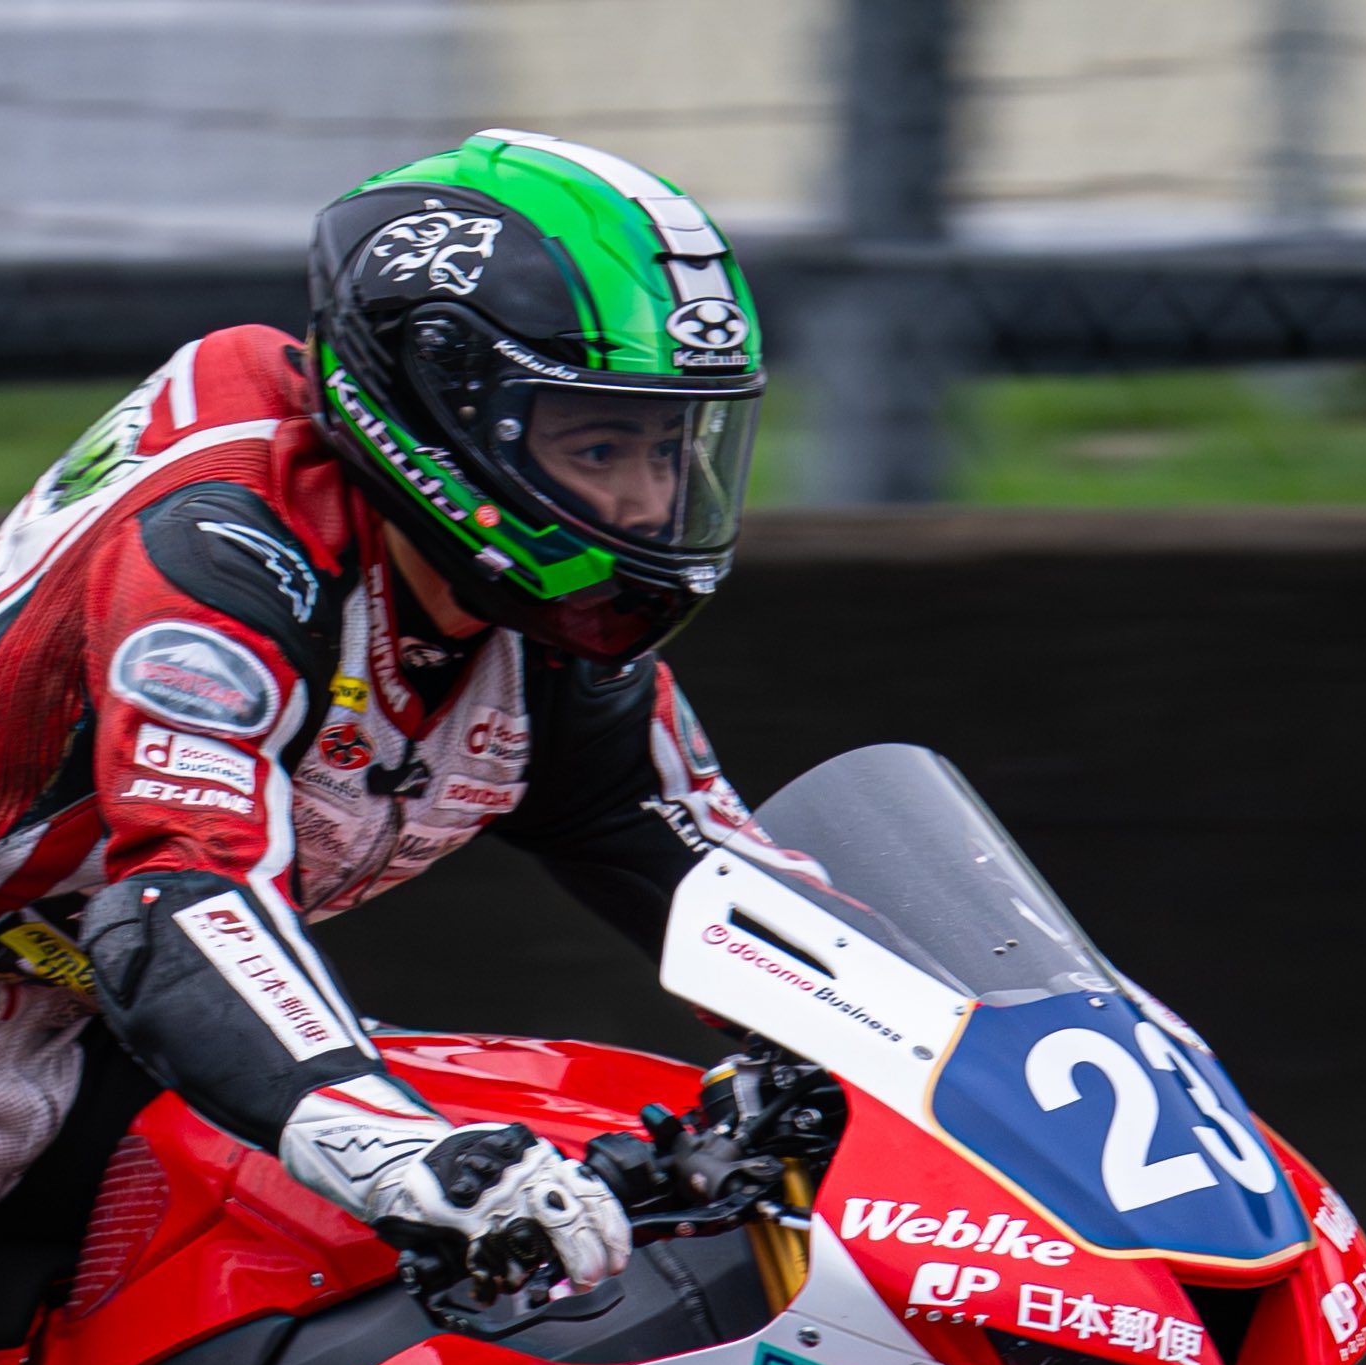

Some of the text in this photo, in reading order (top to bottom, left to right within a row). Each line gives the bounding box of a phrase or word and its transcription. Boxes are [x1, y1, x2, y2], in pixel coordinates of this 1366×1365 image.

[327, 369, 469, 521] Kabuto
[121, 778, 255, 815] JET-LINE
[727, 939, 904, 1043] docomo Business
[1025, 1021, 1278, 1213] 23
[904, 1307, 990, 1329] POST
[908, 1262, 1001, 1306] JP
